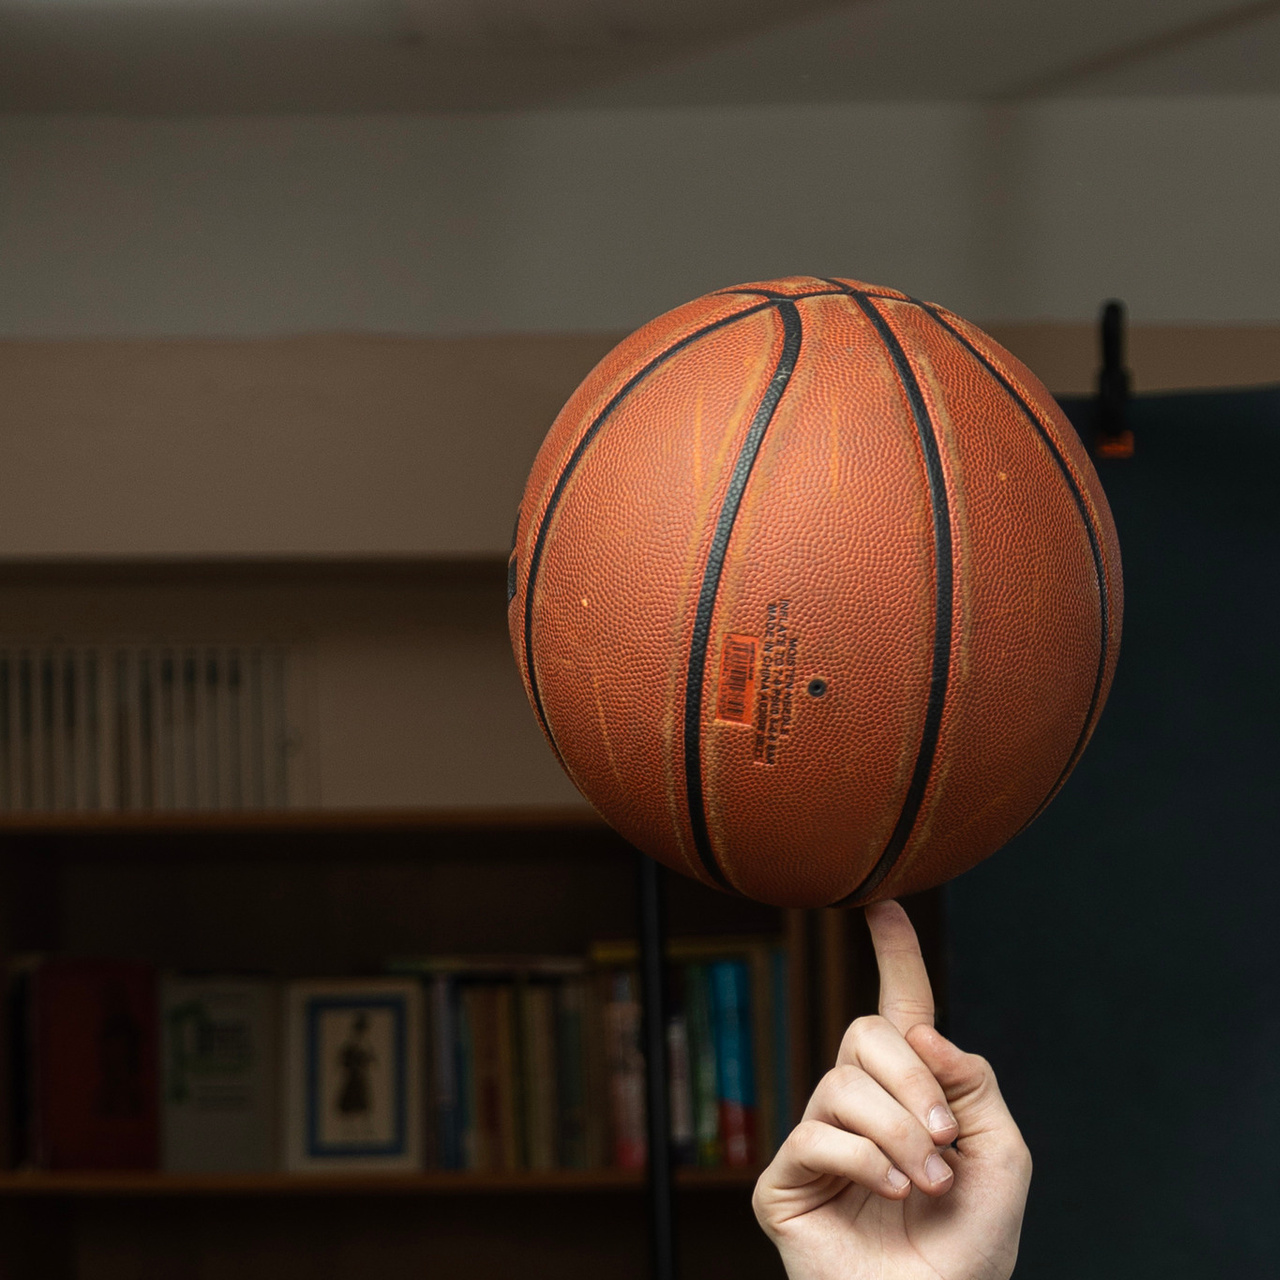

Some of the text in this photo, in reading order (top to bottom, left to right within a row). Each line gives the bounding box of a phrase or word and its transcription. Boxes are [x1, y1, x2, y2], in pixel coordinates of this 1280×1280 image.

[765, 604, 776, 637] MADE
[776, 599, 789, 646] INFLATE
[764, 642, 774, 652] IN
[774, 651, 785, 666] TO
[760, 656, 772, 690] CHINA
[780, 638, 797, 735] MOISTEN NEEDLE
[766, 744, 776, 765] BAR
